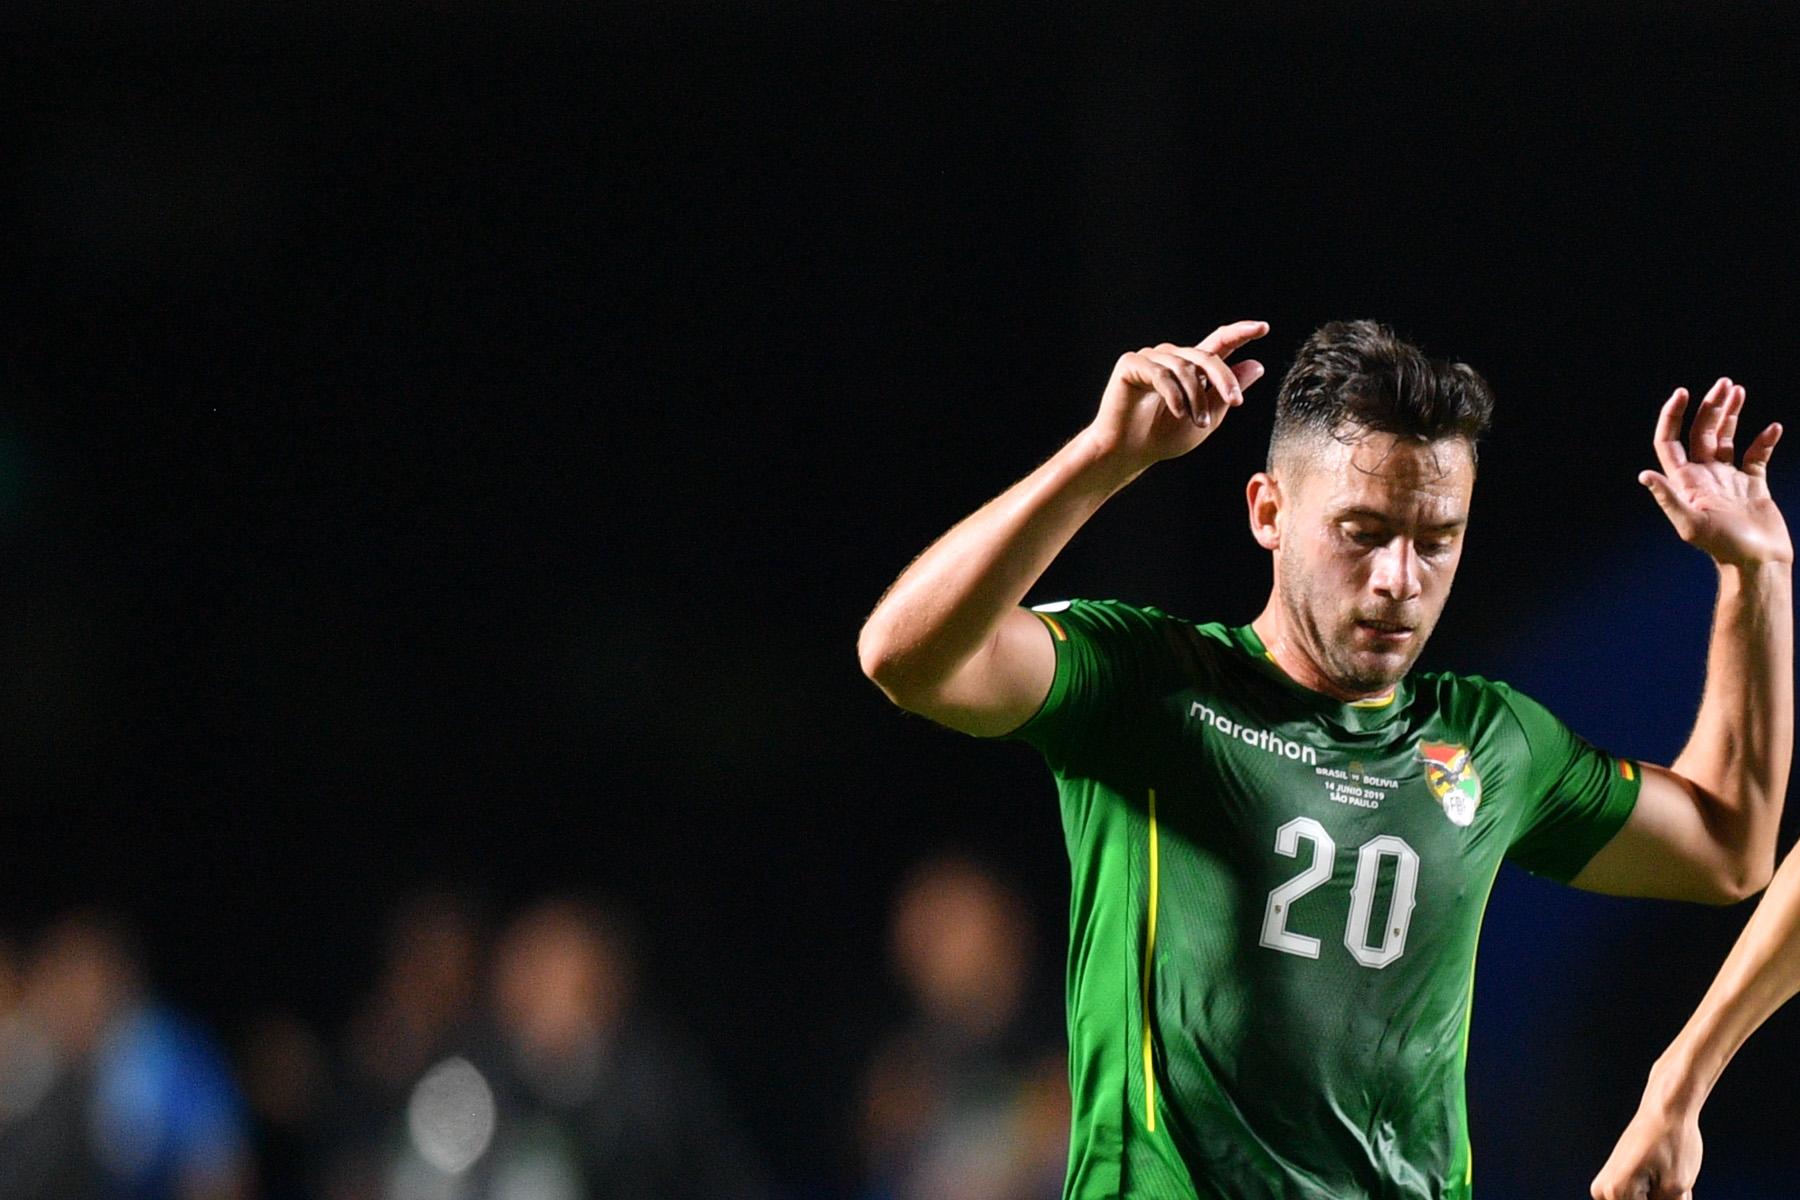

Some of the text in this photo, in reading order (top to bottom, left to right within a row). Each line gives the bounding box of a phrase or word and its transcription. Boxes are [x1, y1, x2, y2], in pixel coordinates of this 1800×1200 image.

[1190, 701, 1317, 766] marathon
[1315, 767, 1348, 780] BRASIL
[1363, 775, 1399, 789] BOLIVIA
[1324, 781, 1385, 800] 14 JUNIO 2019
[1348, 796, 1379, 809] PAULO
[1259, 816, 1420, 970] 20
